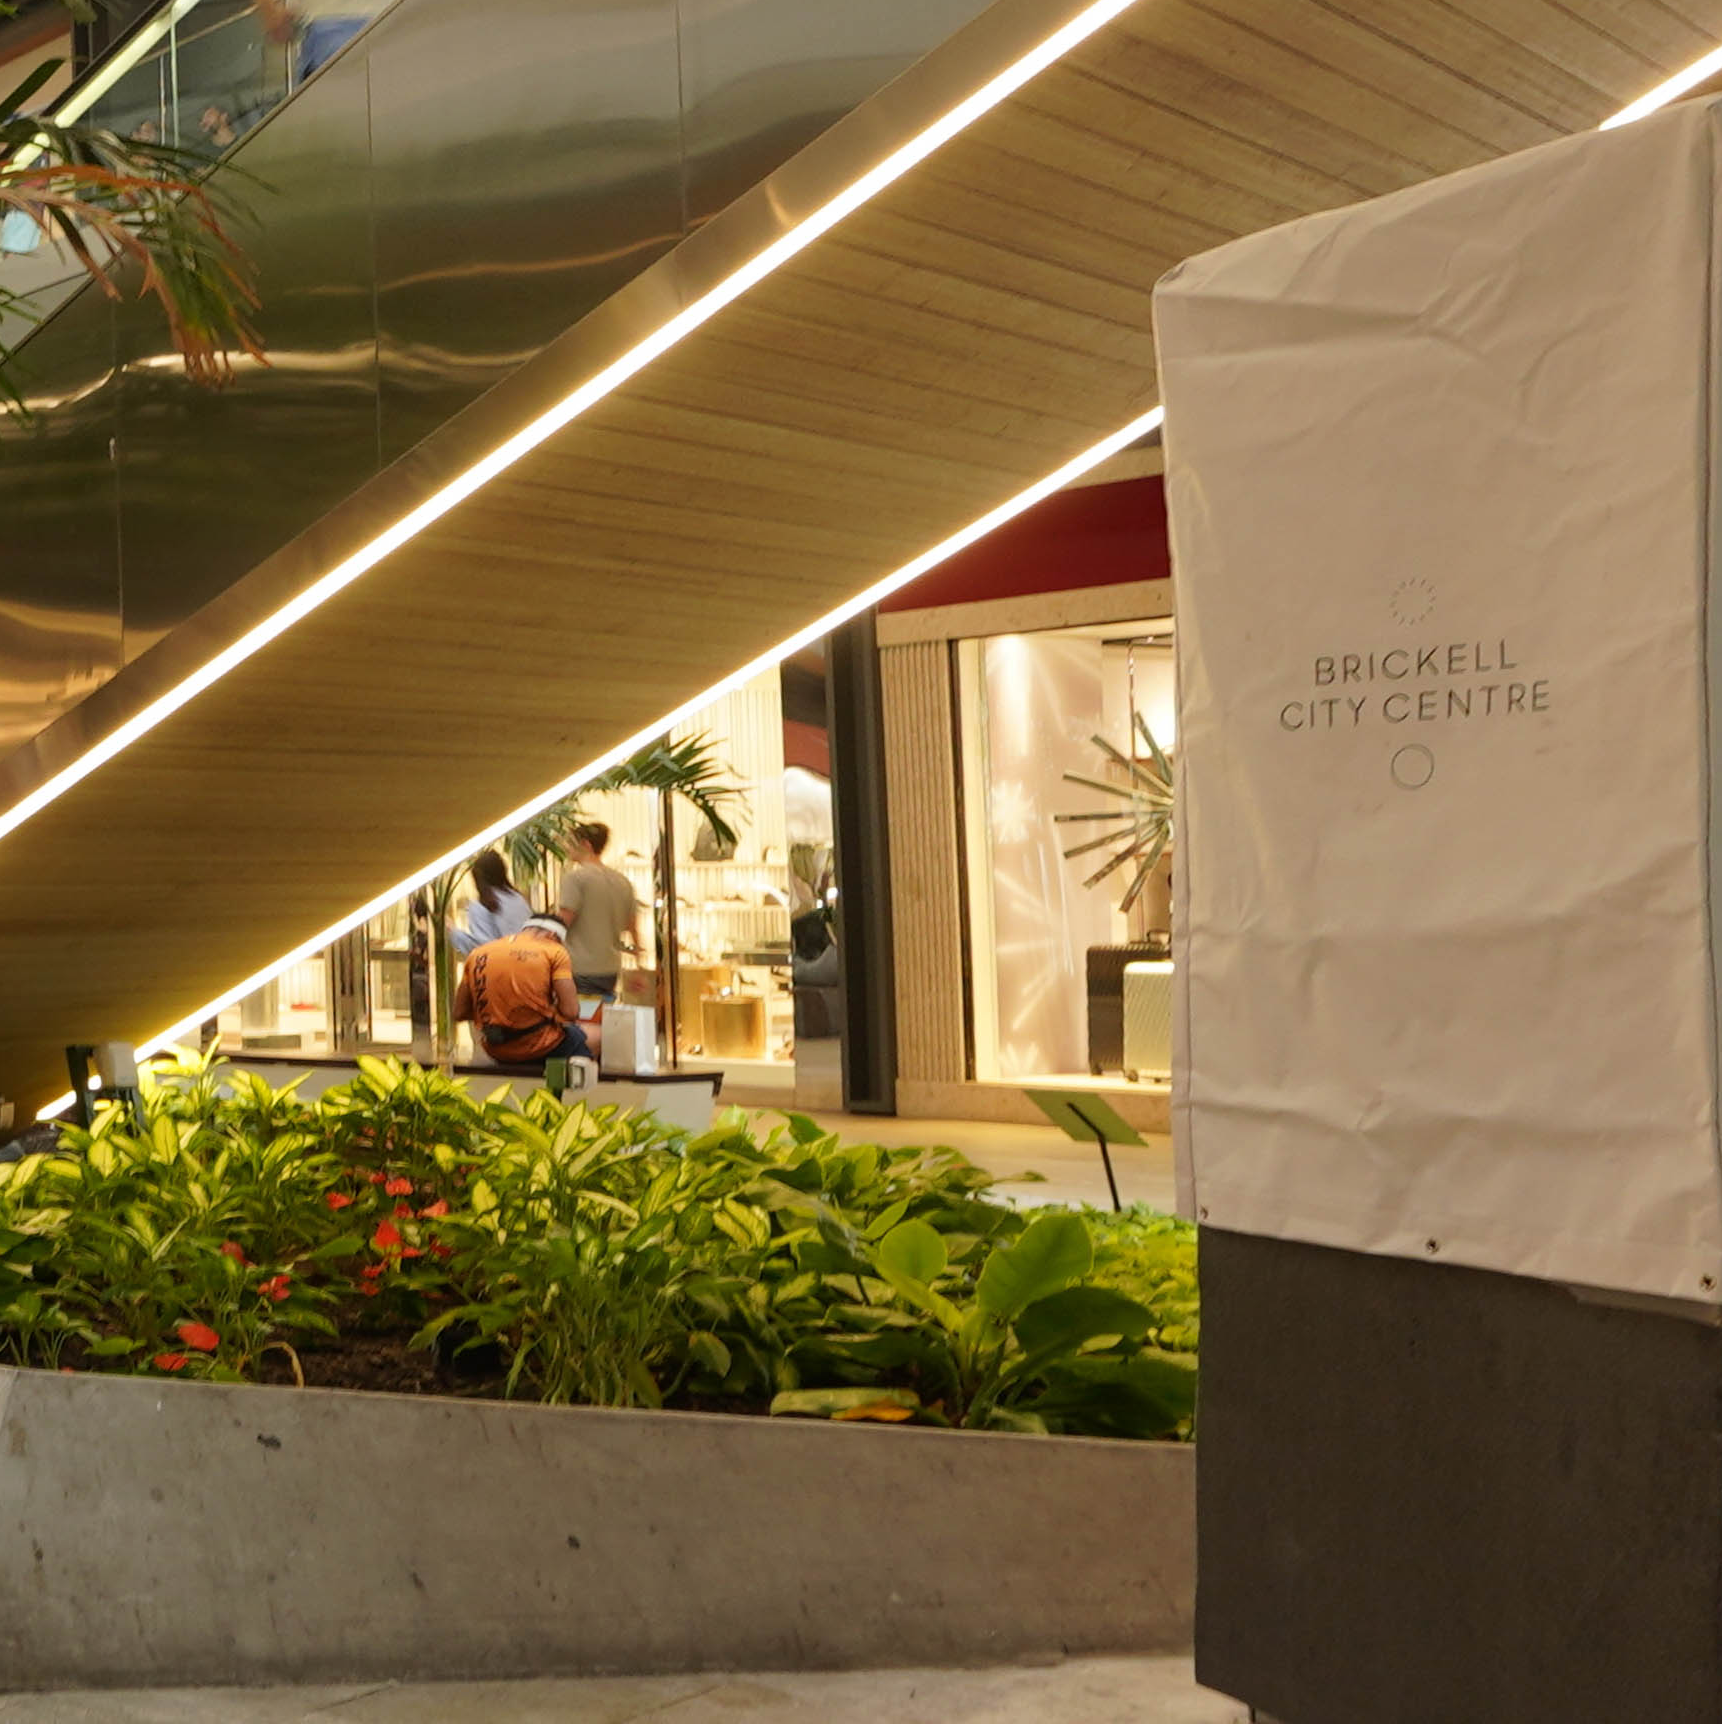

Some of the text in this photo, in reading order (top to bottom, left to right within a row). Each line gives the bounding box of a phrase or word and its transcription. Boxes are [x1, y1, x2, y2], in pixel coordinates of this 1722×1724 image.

[1314, 638, 1519, 687] BRICKELL
[1279, 679, 1551, 731] CITY CENTRE
